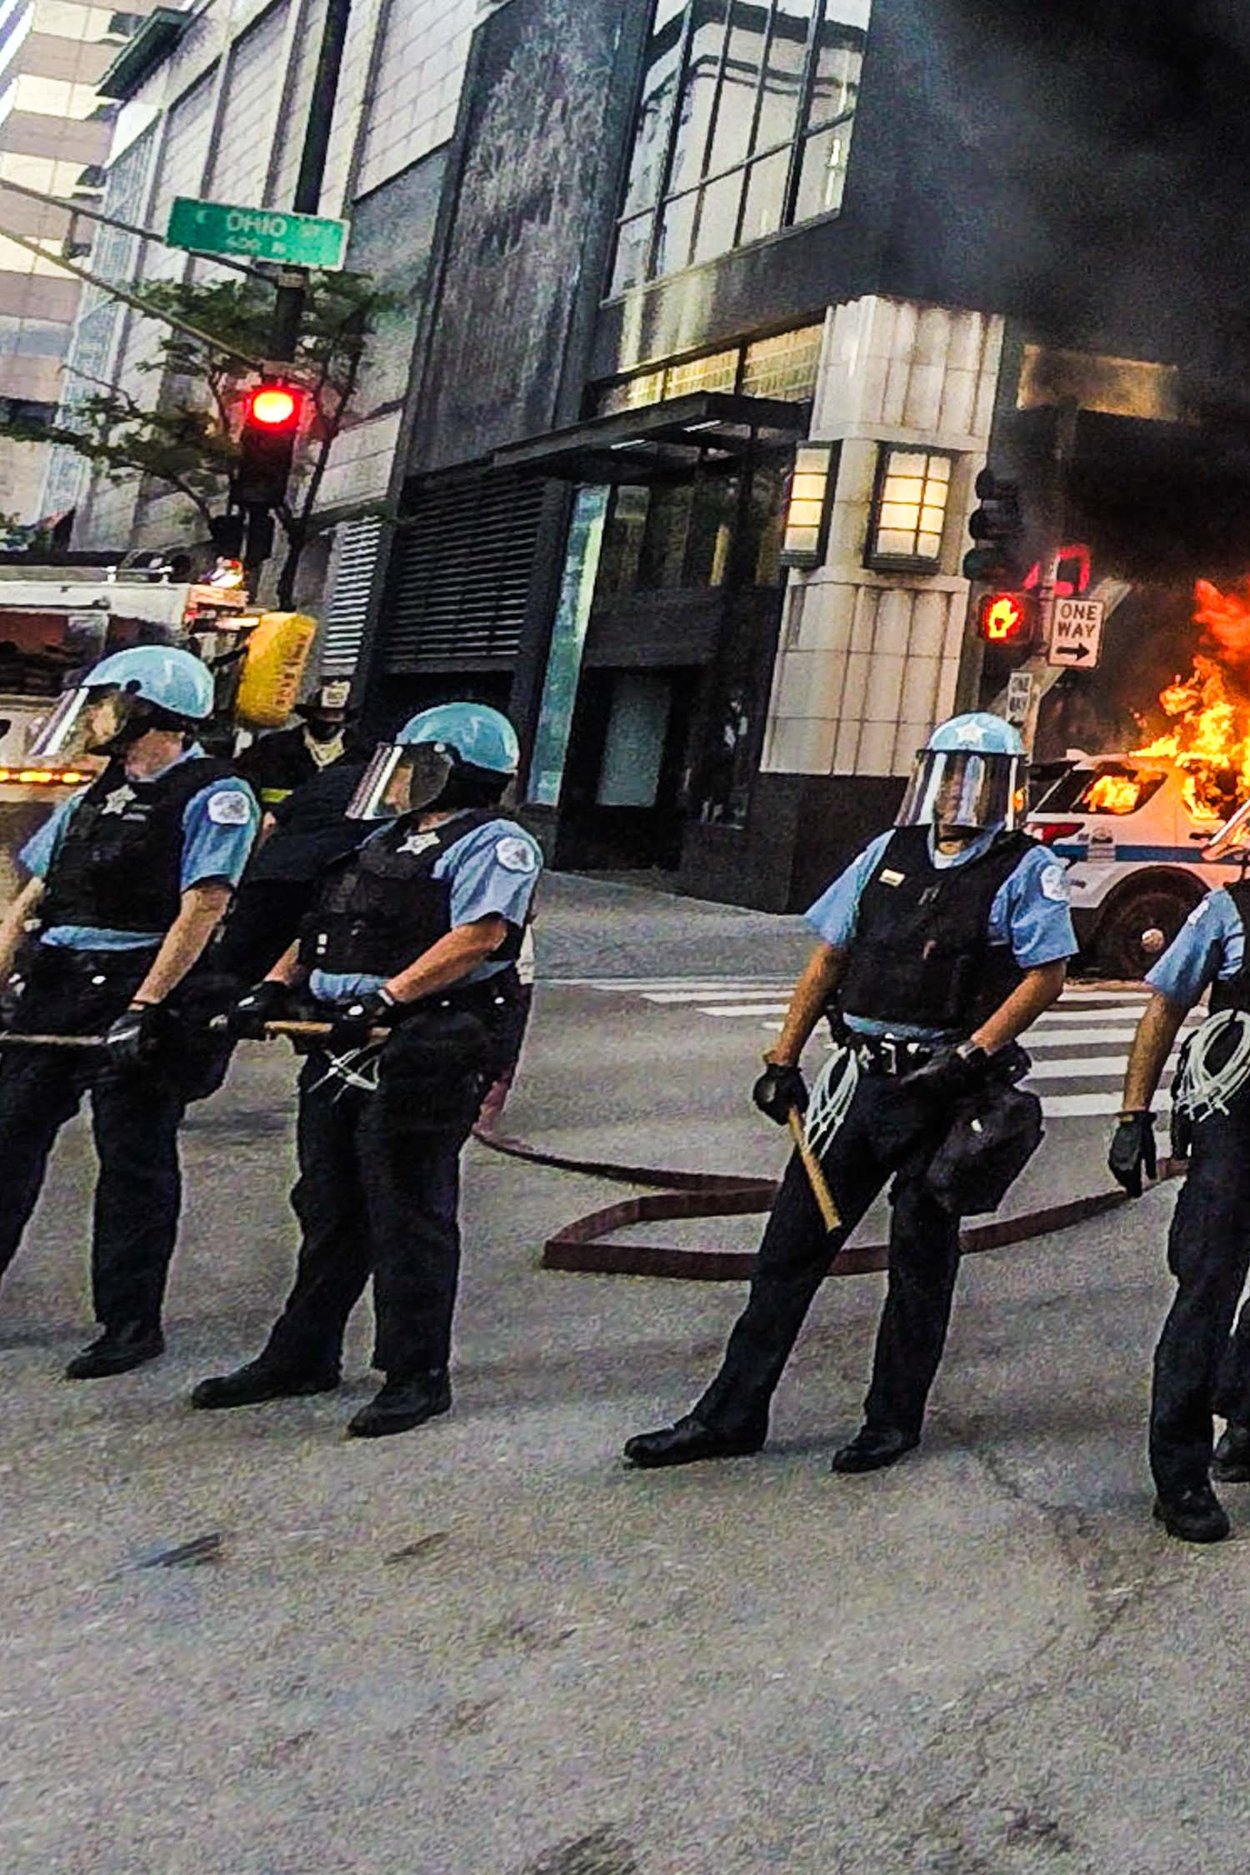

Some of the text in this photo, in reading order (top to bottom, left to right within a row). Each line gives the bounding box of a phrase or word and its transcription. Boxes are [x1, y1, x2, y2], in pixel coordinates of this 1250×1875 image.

[226, 211, 288, 238] OHIO
[1060, 602, 1098, 621] ONE
[1057, 622, 1096, 639] WAY
